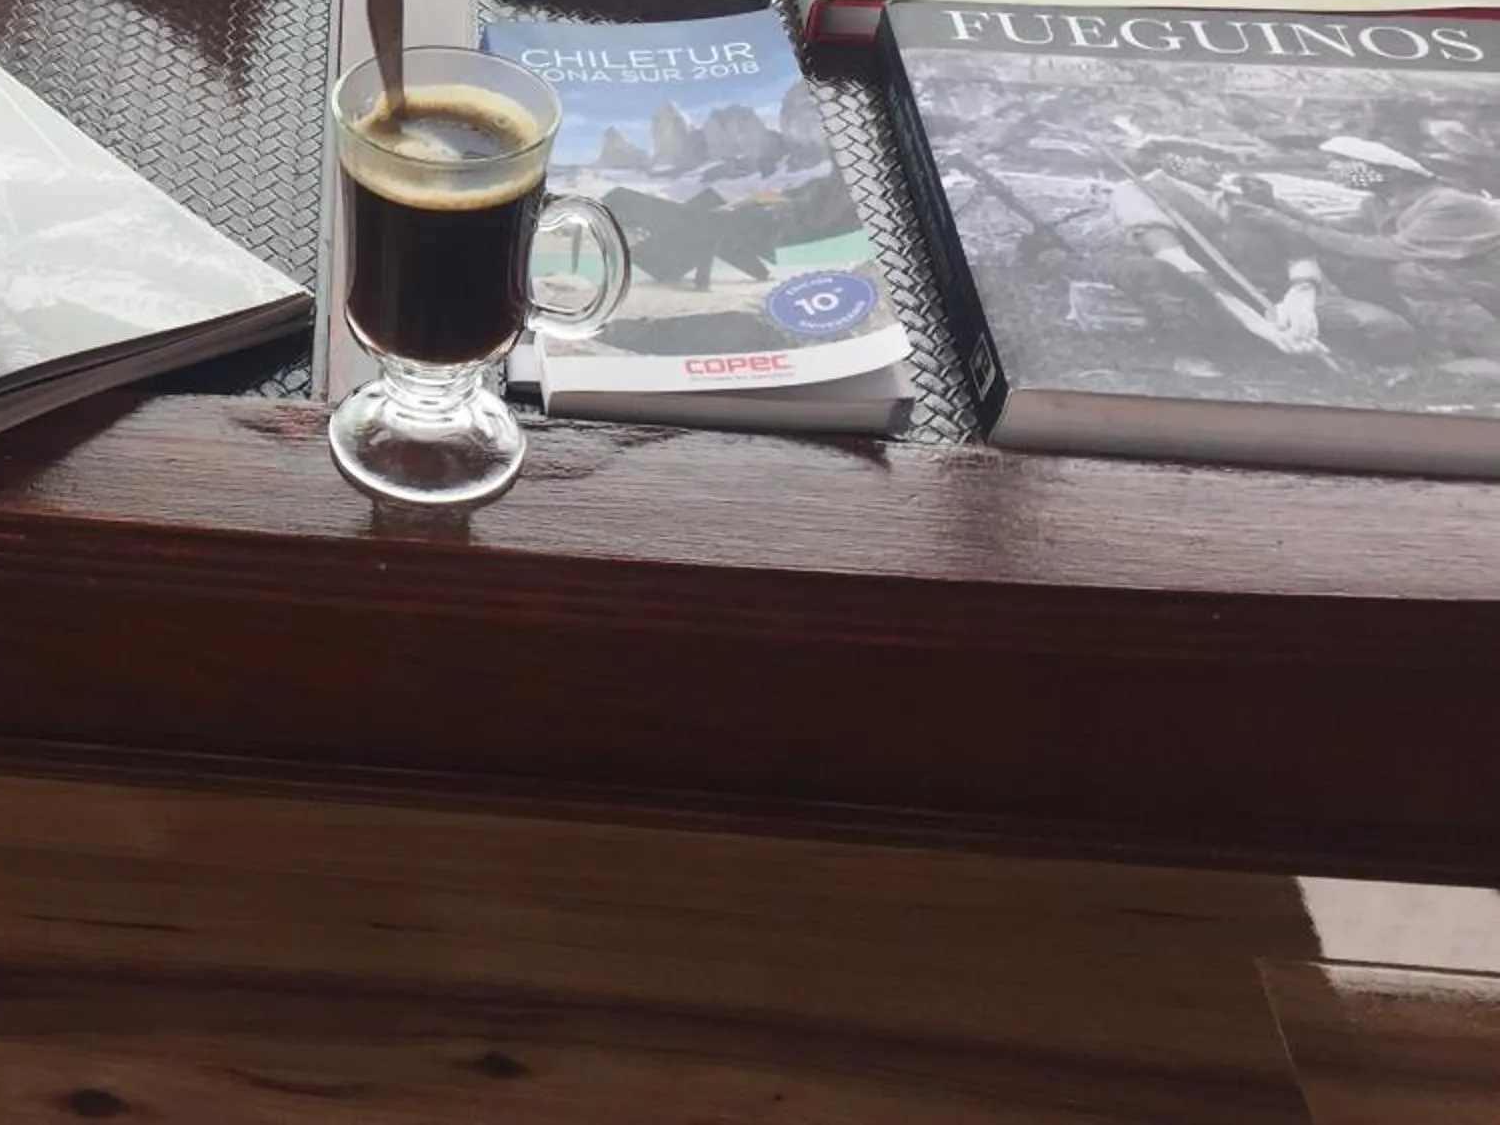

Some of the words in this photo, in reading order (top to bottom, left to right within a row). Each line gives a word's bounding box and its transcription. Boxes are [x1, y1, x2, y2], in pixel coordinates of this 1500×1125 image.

[941, 9, 1486, 63] FUEGUINOS
[521, 41, 755, 69] CHILETUR
[620, 68, 684, 83] SUR
[690, 61, 760, 80] 2018
